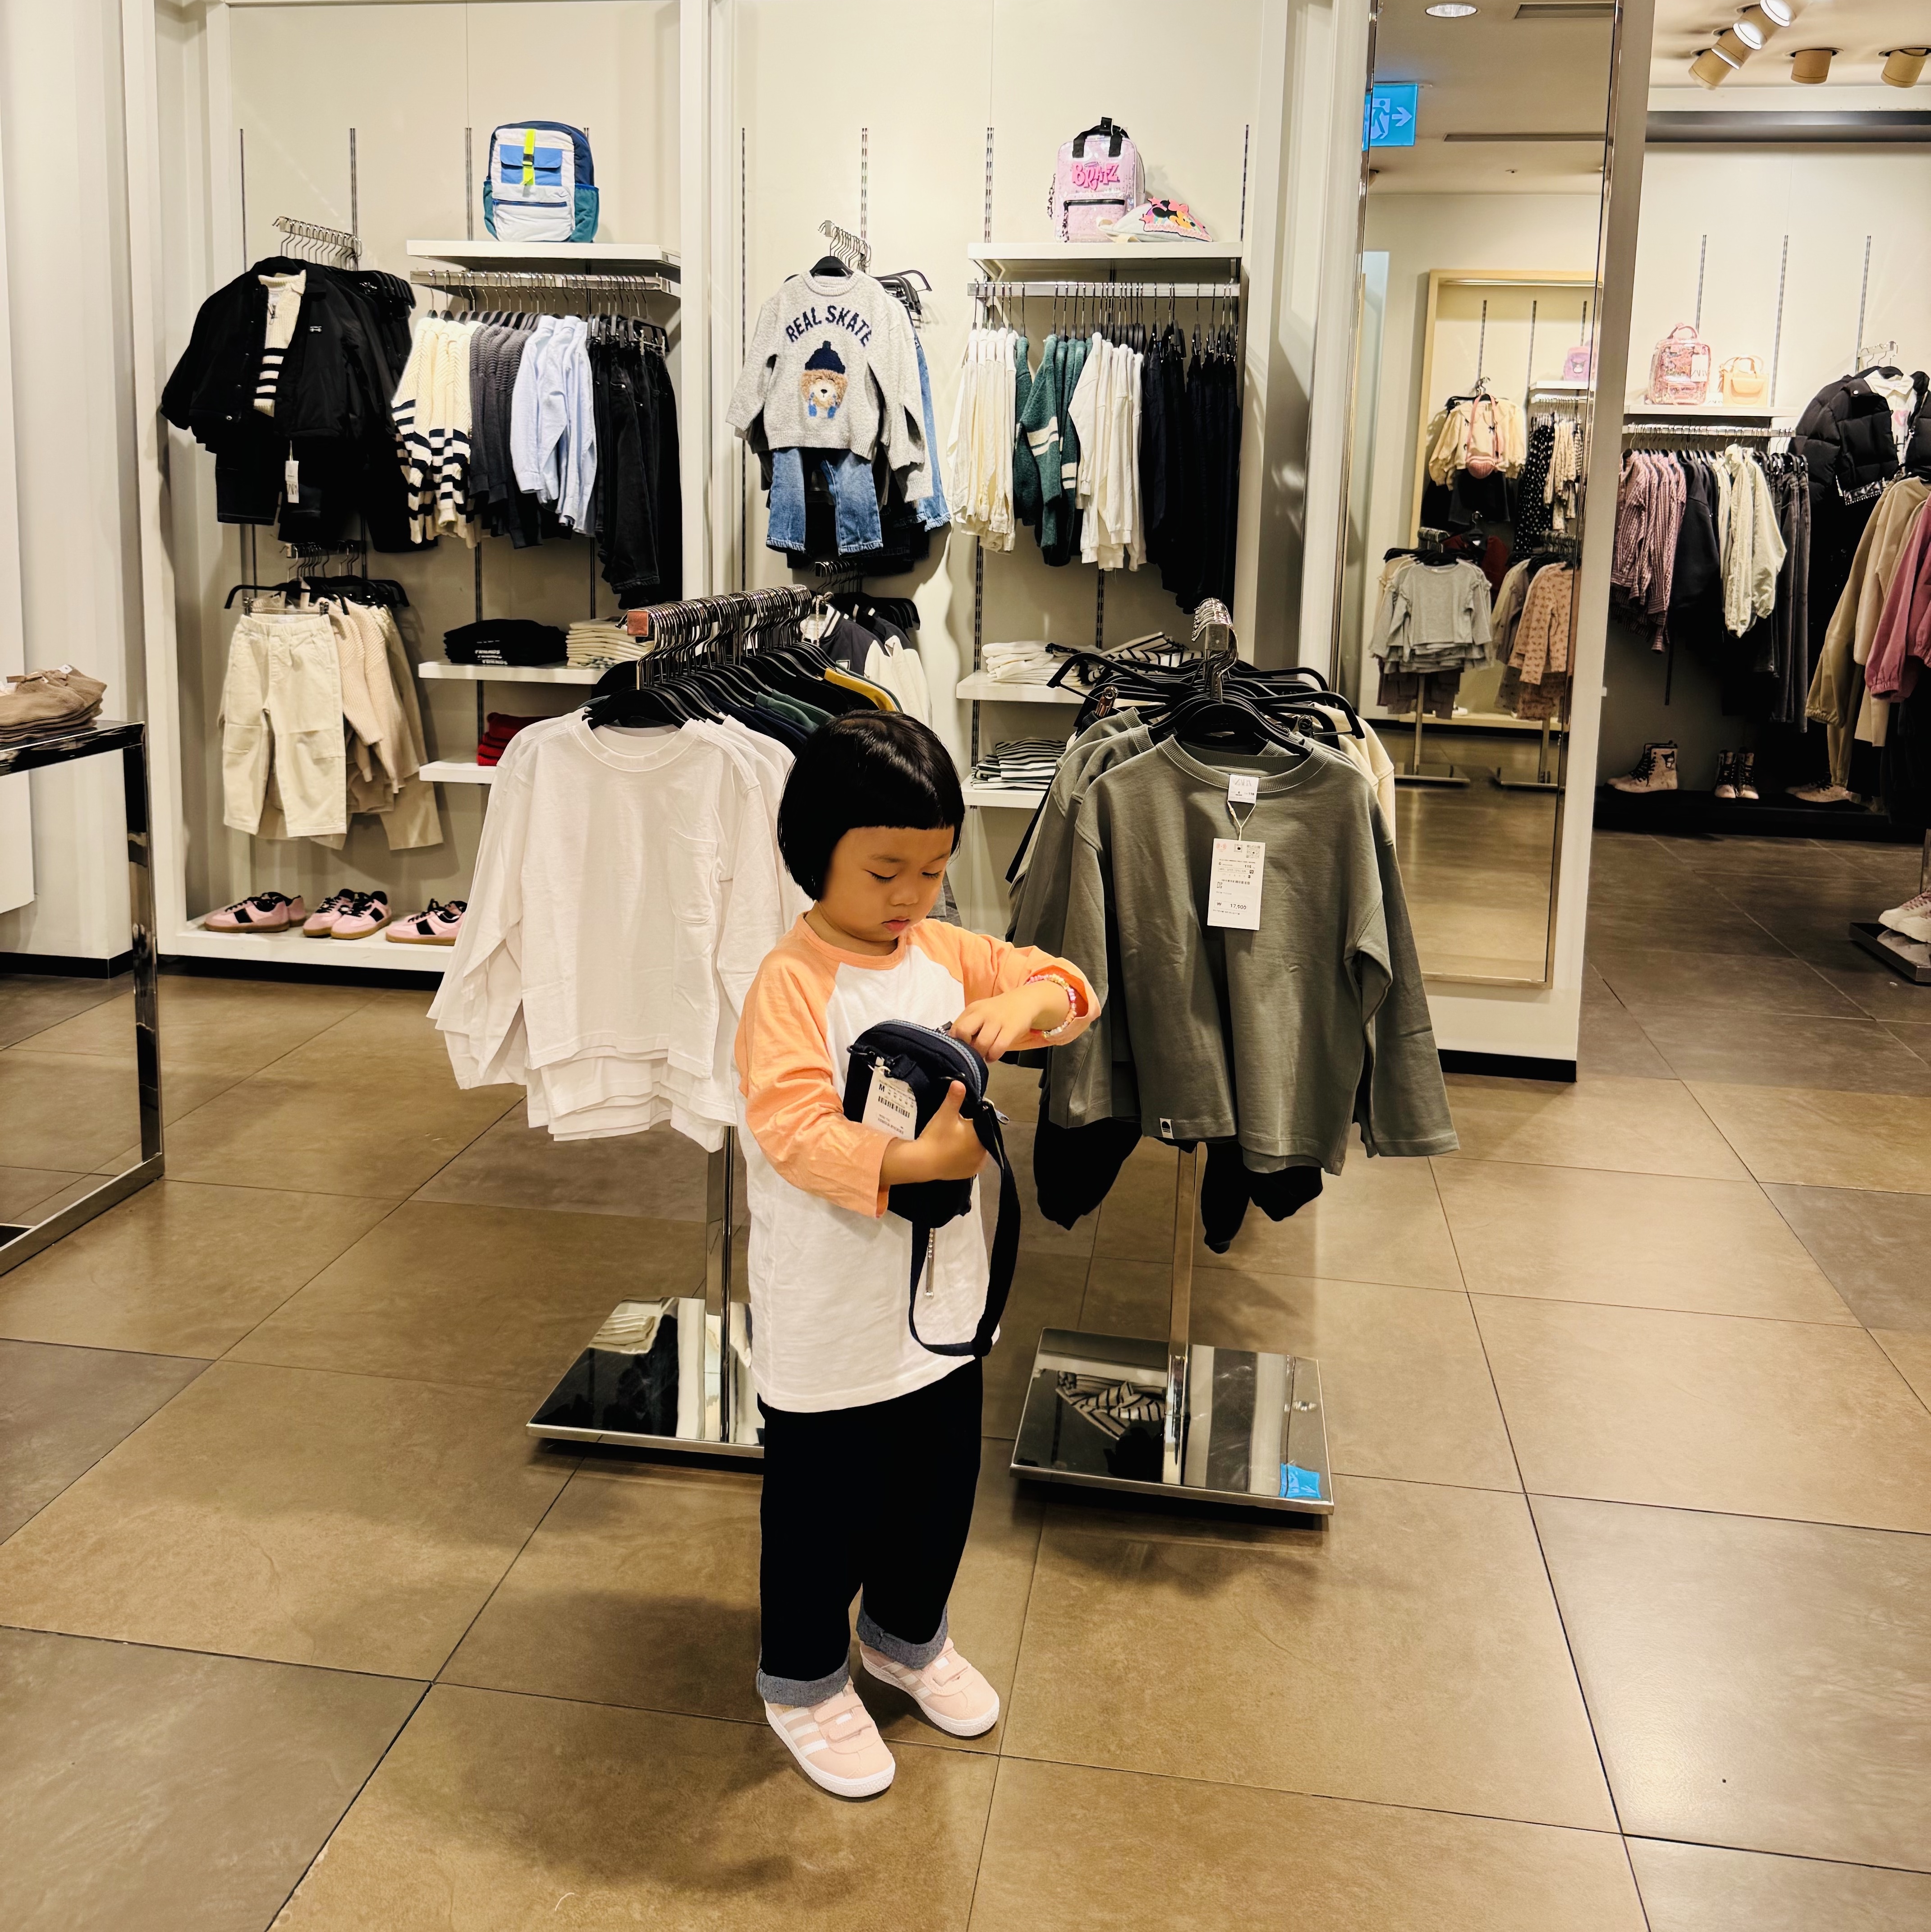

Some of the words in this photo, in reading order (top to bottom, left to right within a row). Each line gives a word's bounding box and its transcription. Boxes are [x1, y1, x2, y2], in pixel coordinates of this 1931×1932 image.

[786, 307, 822, 343] REAL
[825, 305, 872, 347] SKATE
[1234, 778, 1252, 787] ZARA
